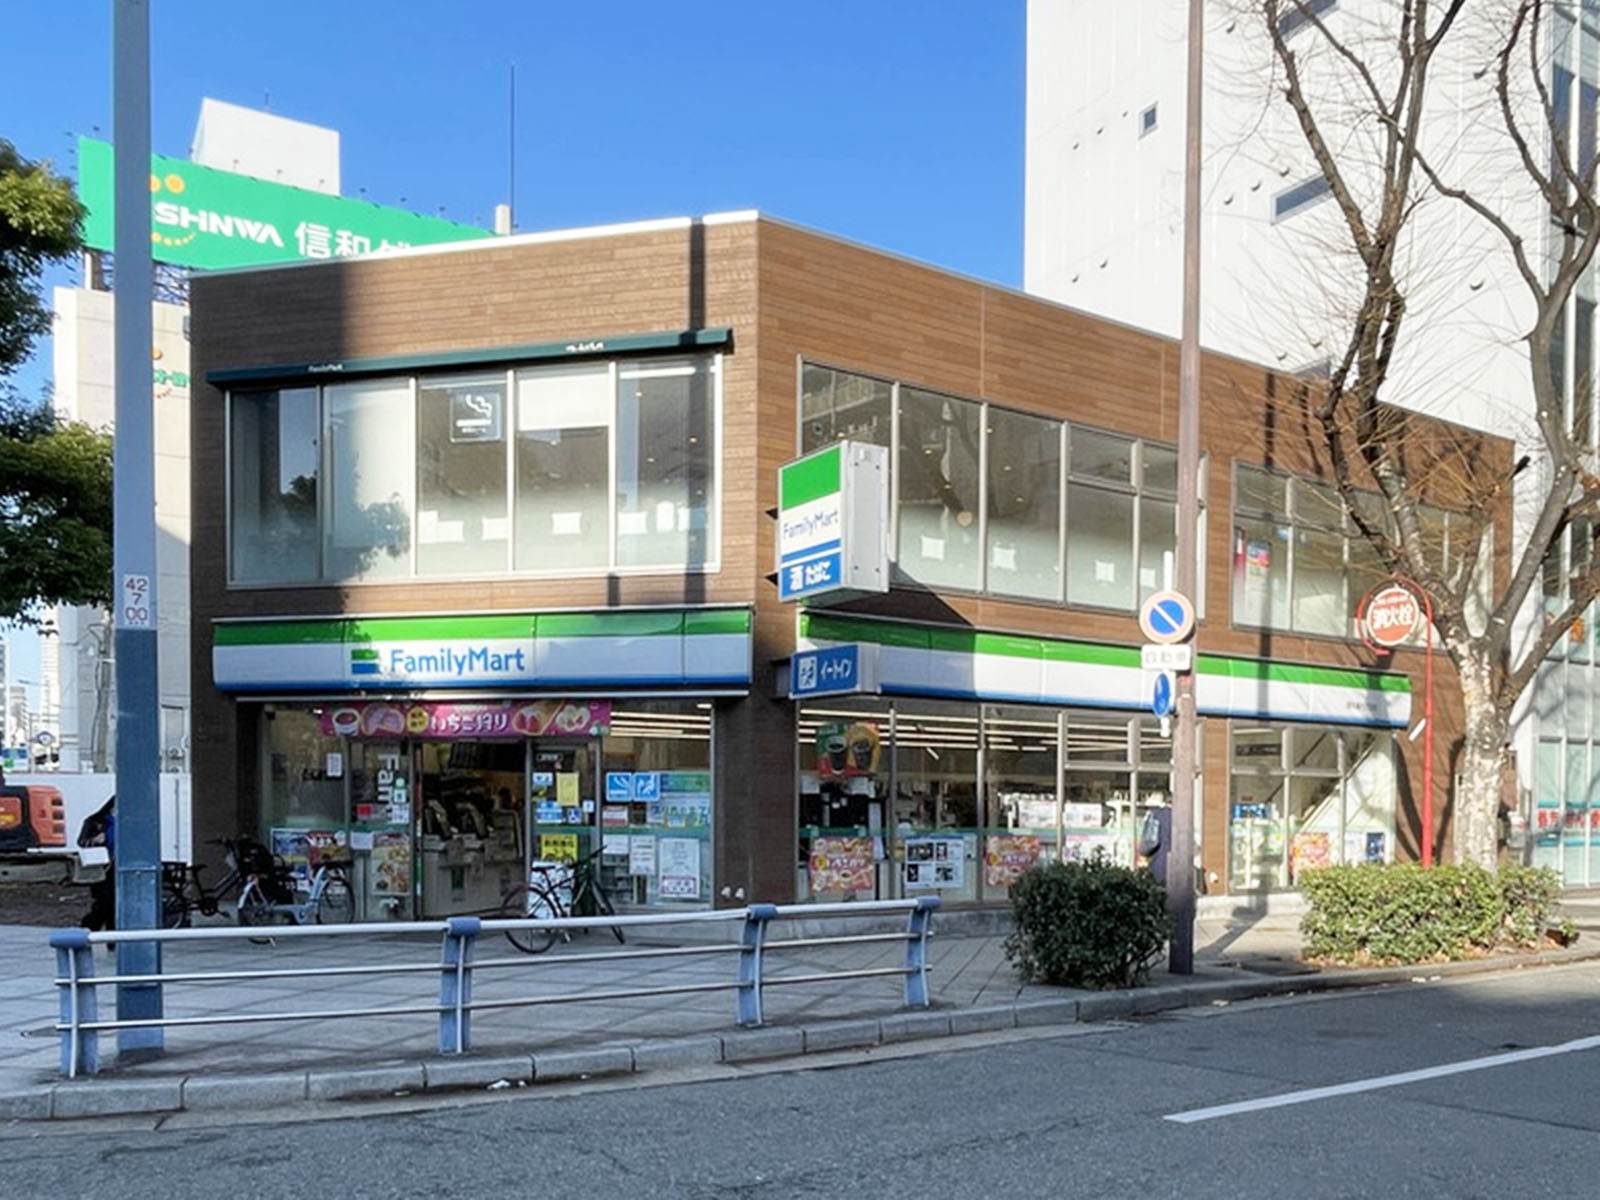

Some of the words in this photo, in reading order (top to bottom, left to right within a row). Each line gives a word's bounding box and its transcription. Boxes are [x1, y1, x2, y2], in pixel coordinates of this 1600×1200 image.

[125, 577, 148, 592] 42
[132, 592, 142, 605] 7
[390, 647, 525, 676] FamilyMart
